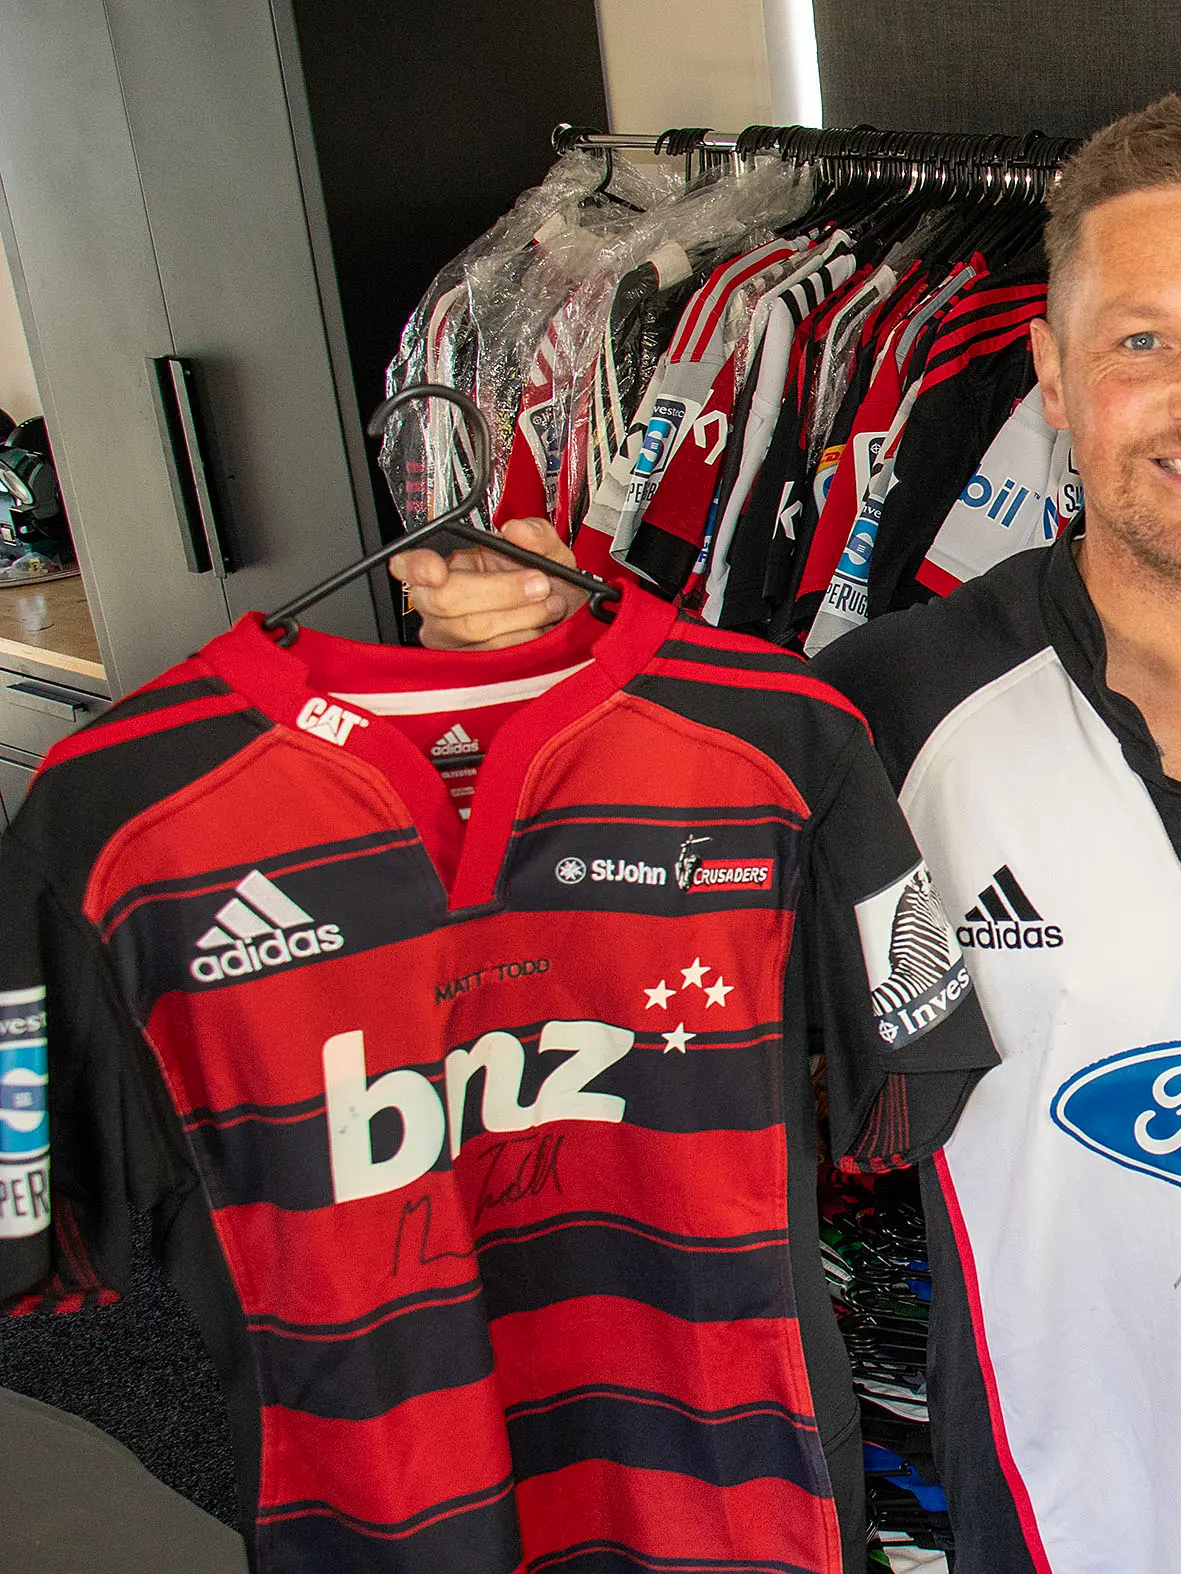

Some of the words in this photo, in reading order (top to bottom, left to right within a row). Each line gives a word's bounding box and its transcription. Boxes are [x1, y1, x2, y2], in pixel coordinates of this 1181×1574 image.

[296, 697, 361, 746] CAT
[431, 739, 479, 756] adidas
[693, 867, 768, 886] CRUSADERS
[190, 923, 345, 982] adidas
[955, 920, 1064, 950] adidas
[324, 1020, 635, 1205] bnz
